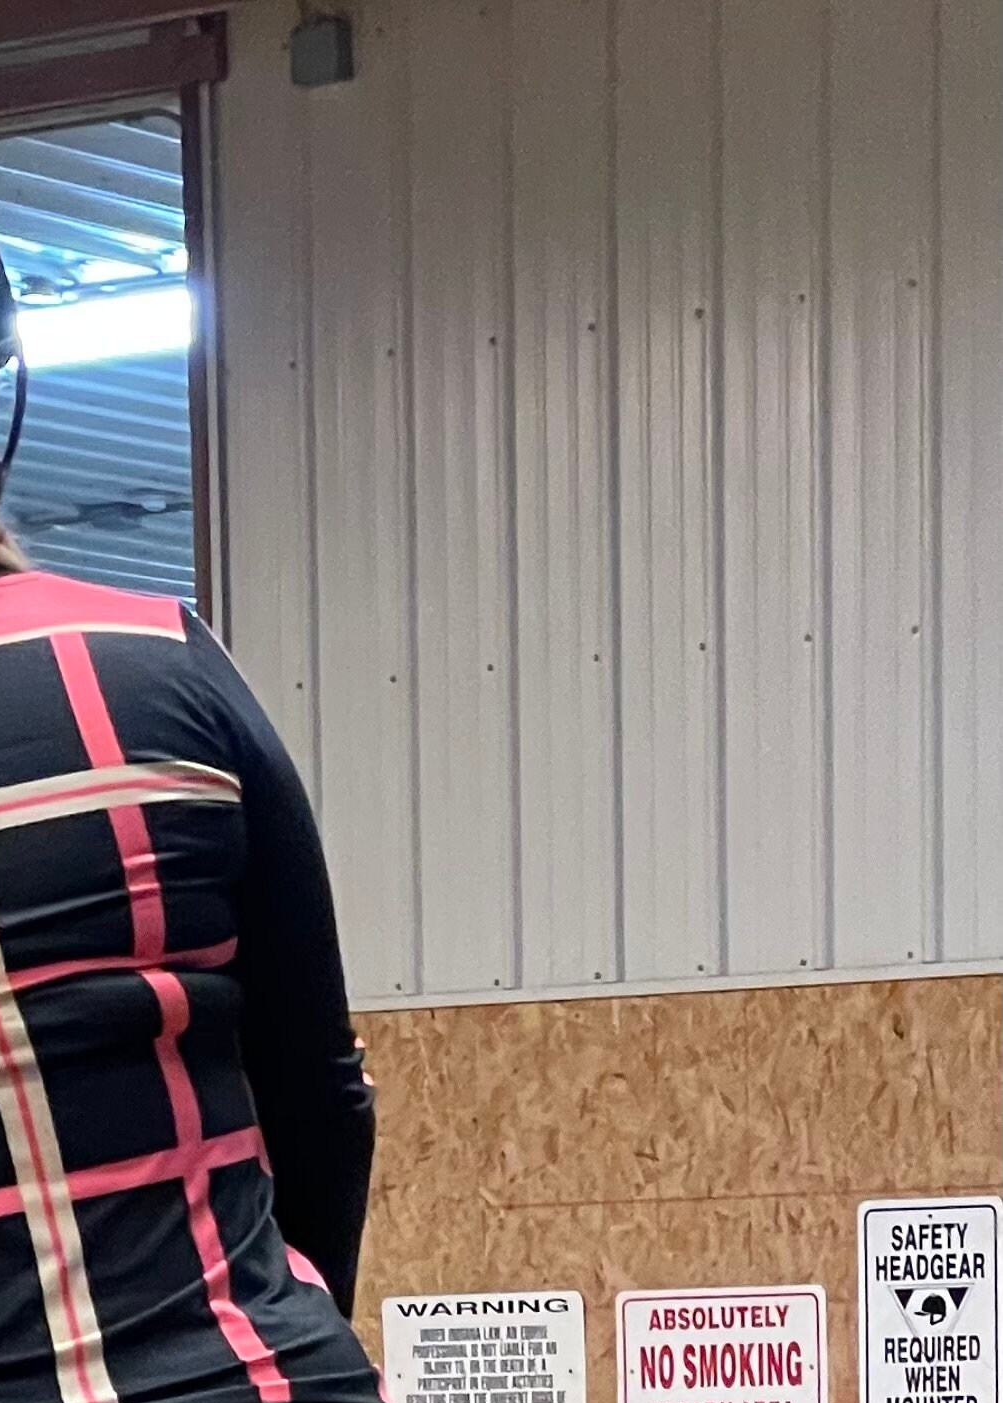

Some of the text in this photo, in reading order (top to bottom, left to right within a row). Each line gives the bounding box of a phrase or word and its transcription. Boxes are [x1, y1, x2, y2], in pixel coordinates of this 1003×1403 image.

[891, 1223, 968, 1252] SAFETY
[875, 1253, 985, 1281] HEADGEAR
[397, 1298, 569, 1318] WARNING
[649, 1305, 790, 1331] ABSOLUTELY
[884, 1335, 981, 1364] REQUIRED
[640, 1341, 803, 1390] NO SMOKING
[905, 1366, 960, 1394] WHEN
